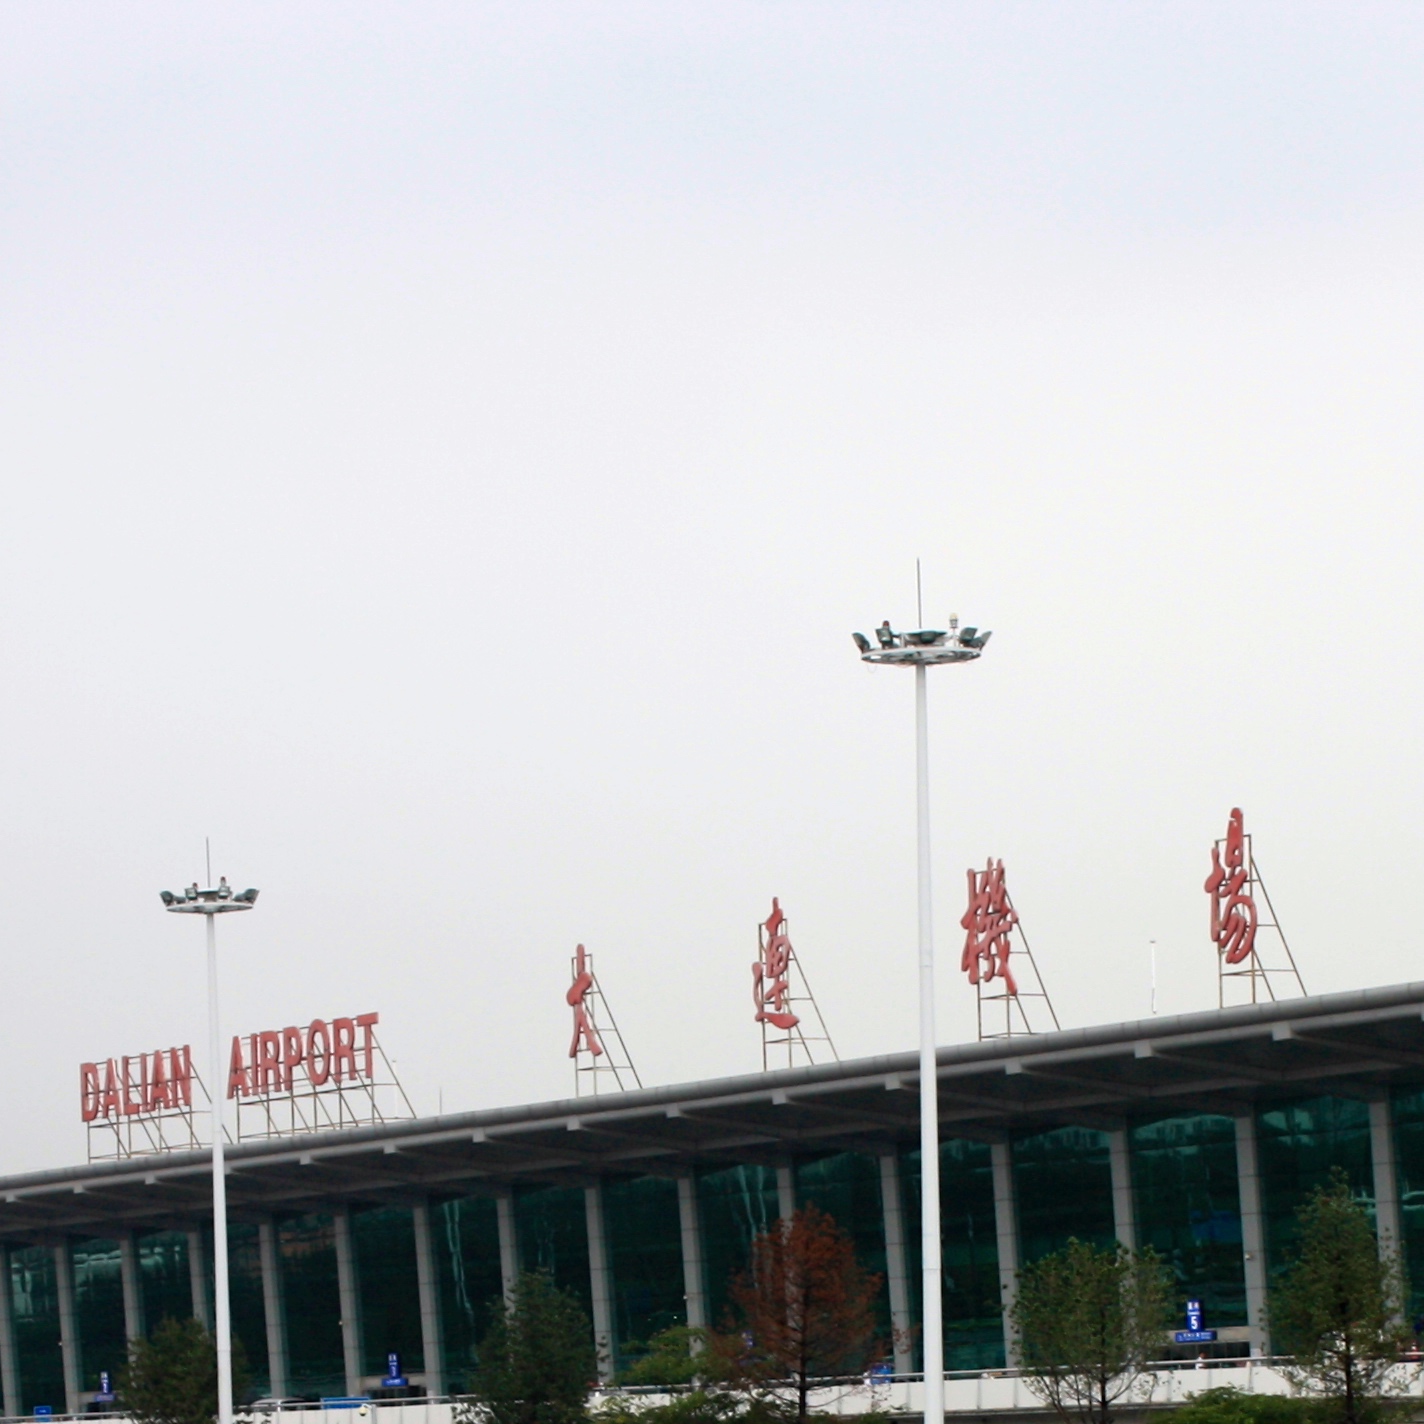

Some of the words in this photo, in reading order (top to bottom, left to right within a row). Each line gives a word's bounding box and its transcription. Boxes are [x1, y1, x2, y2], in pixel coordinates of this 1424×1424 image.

[80, 1044, 192, 1122] DALIAN
[227, 1012, 379, 1099] AIRPORT
[1191, 1315, 1198, 1330] 5
